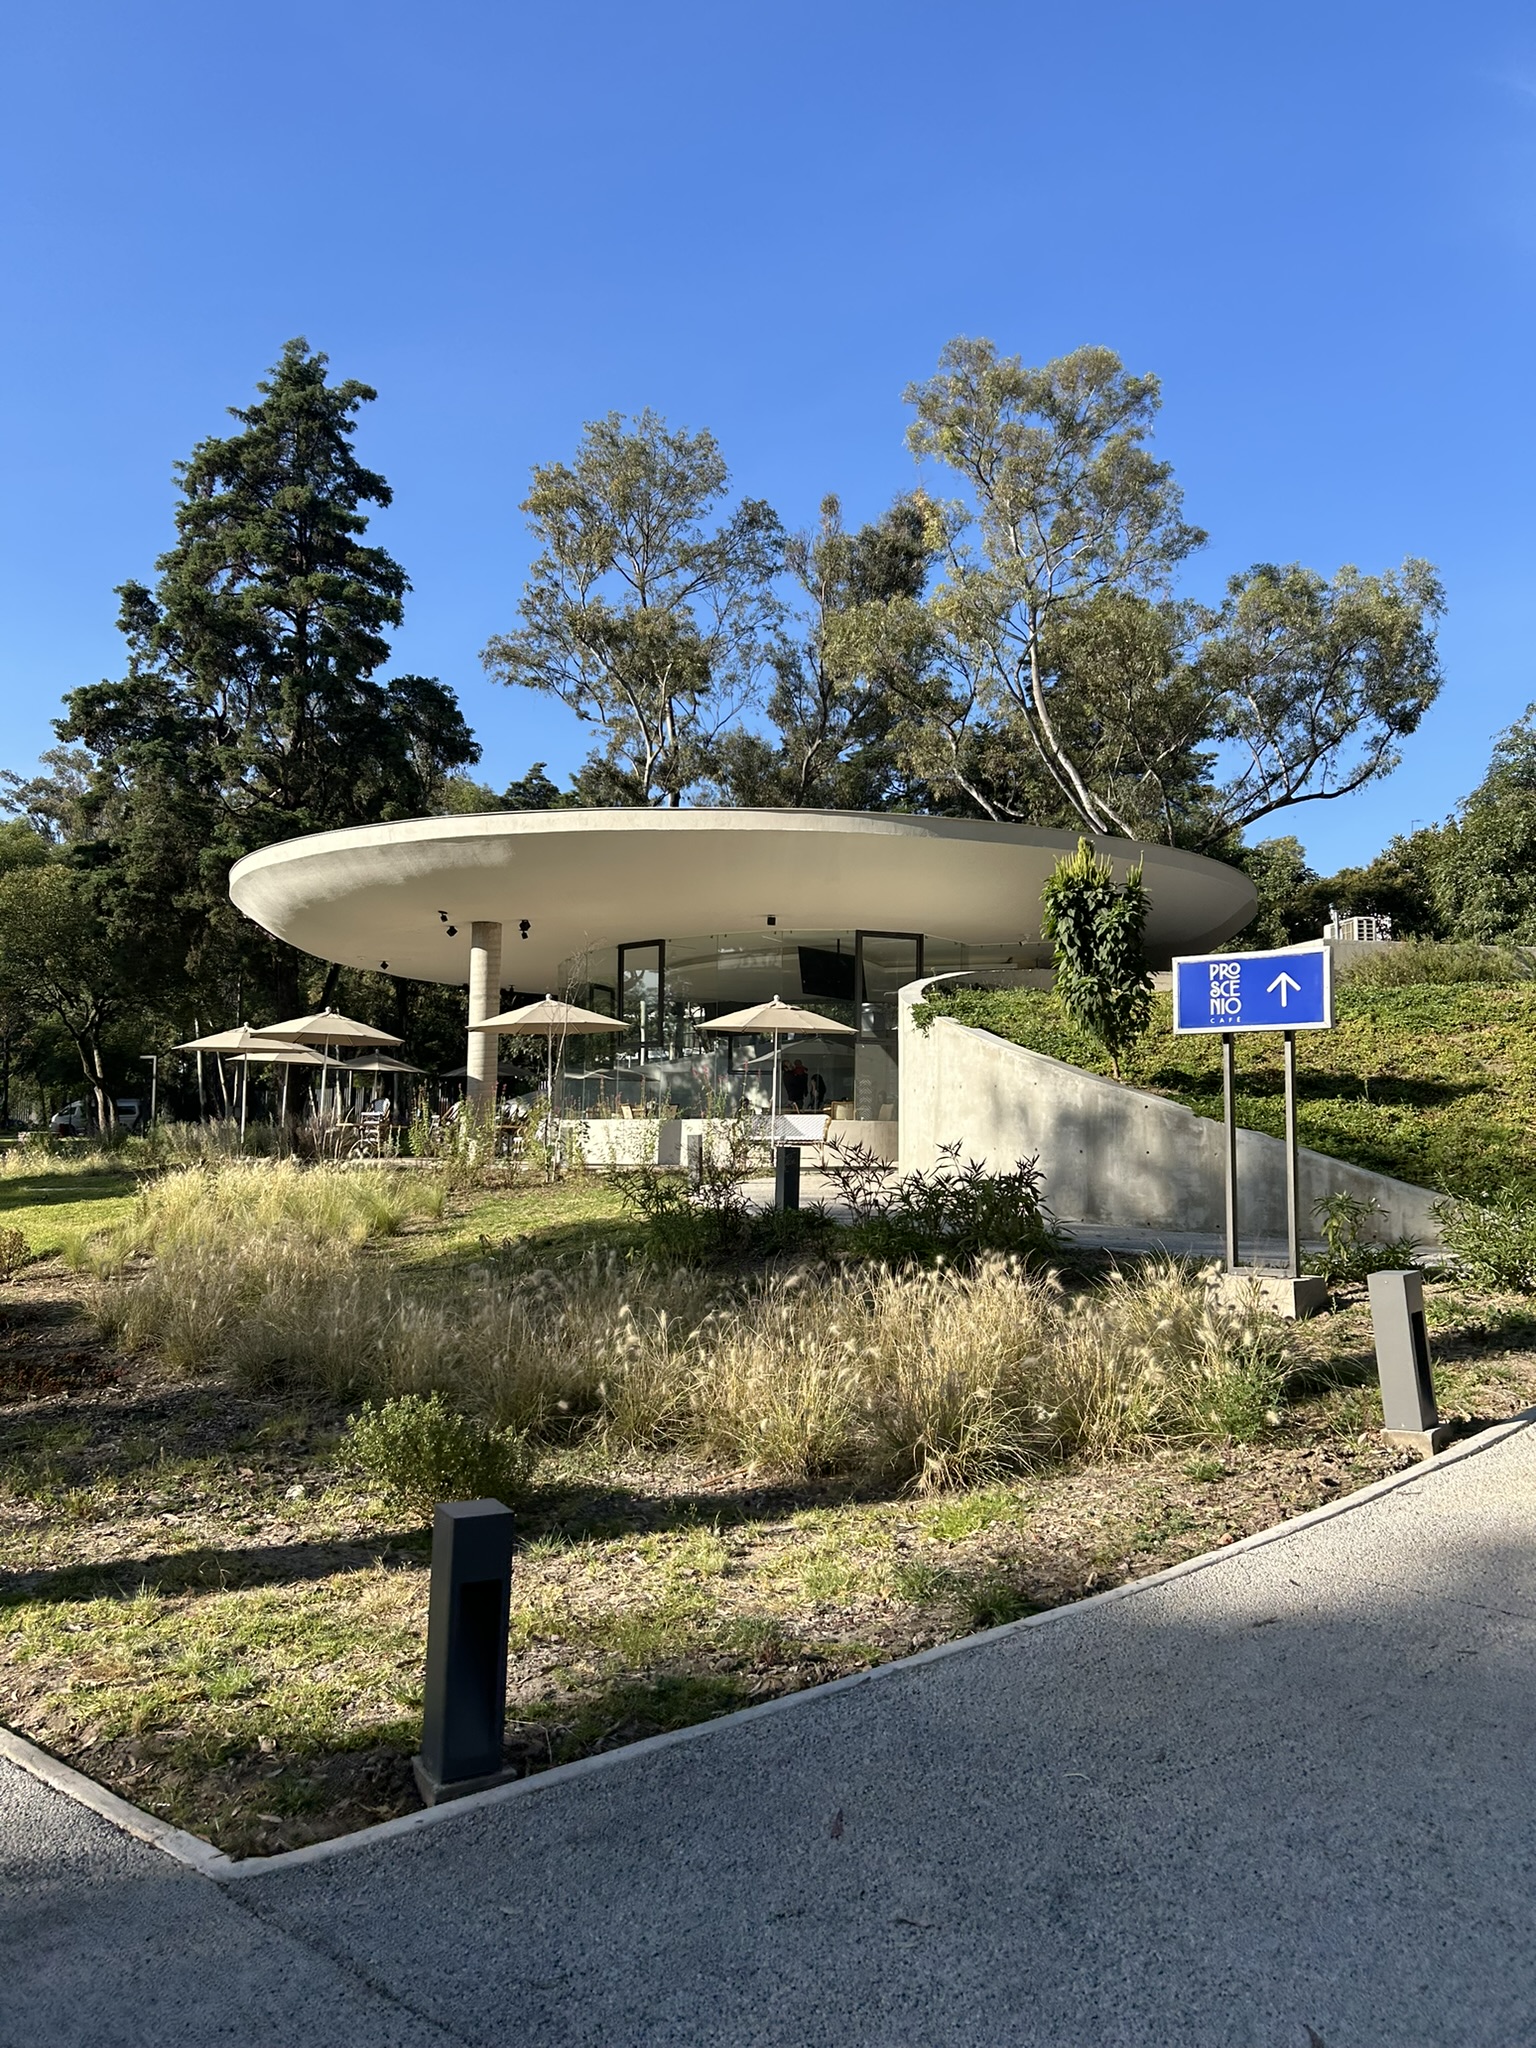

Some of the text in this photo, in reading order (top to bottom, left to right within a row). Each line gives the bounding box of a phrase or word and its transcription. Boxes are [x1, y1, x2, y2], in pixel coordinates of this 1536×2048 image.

[1209, 962, 1241, 980] PRO
[1210, 980, 1241, 997] SCE
[1210, 997, 1242, 1015] NIO
